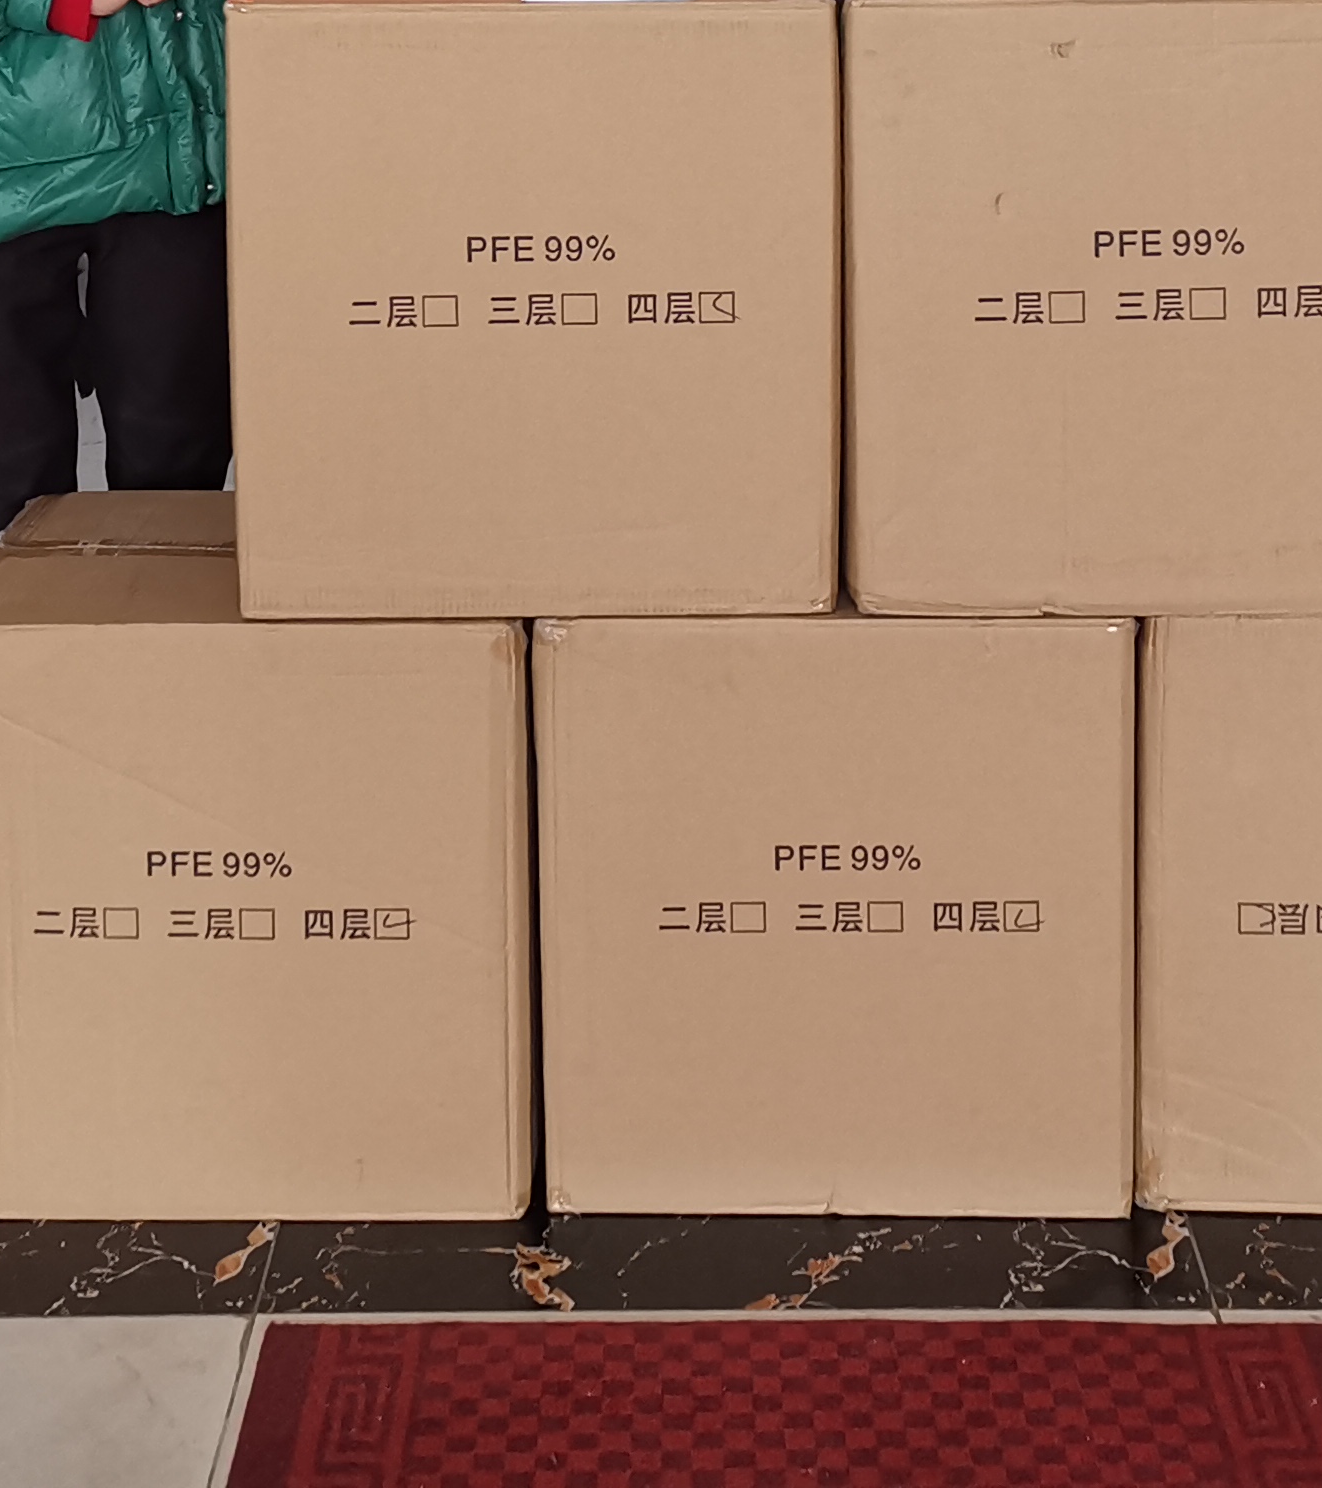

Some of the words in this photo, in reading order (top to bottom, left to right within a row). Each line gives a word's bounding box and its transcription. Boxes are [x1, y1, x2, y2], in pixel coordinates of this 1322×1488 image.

[467, 236, 534, 262] PFE
[545, 235, 615, 261] 99%
[1095, 230, 1161, 258] PFE
[1173, 228, 1244, 256] 99%
[147, 851, 213, 876] PFE
[223, 852, 292, 877] 99%
[775, 845, 841, 871] PFE
[852, 845, 921, 871] 99%
